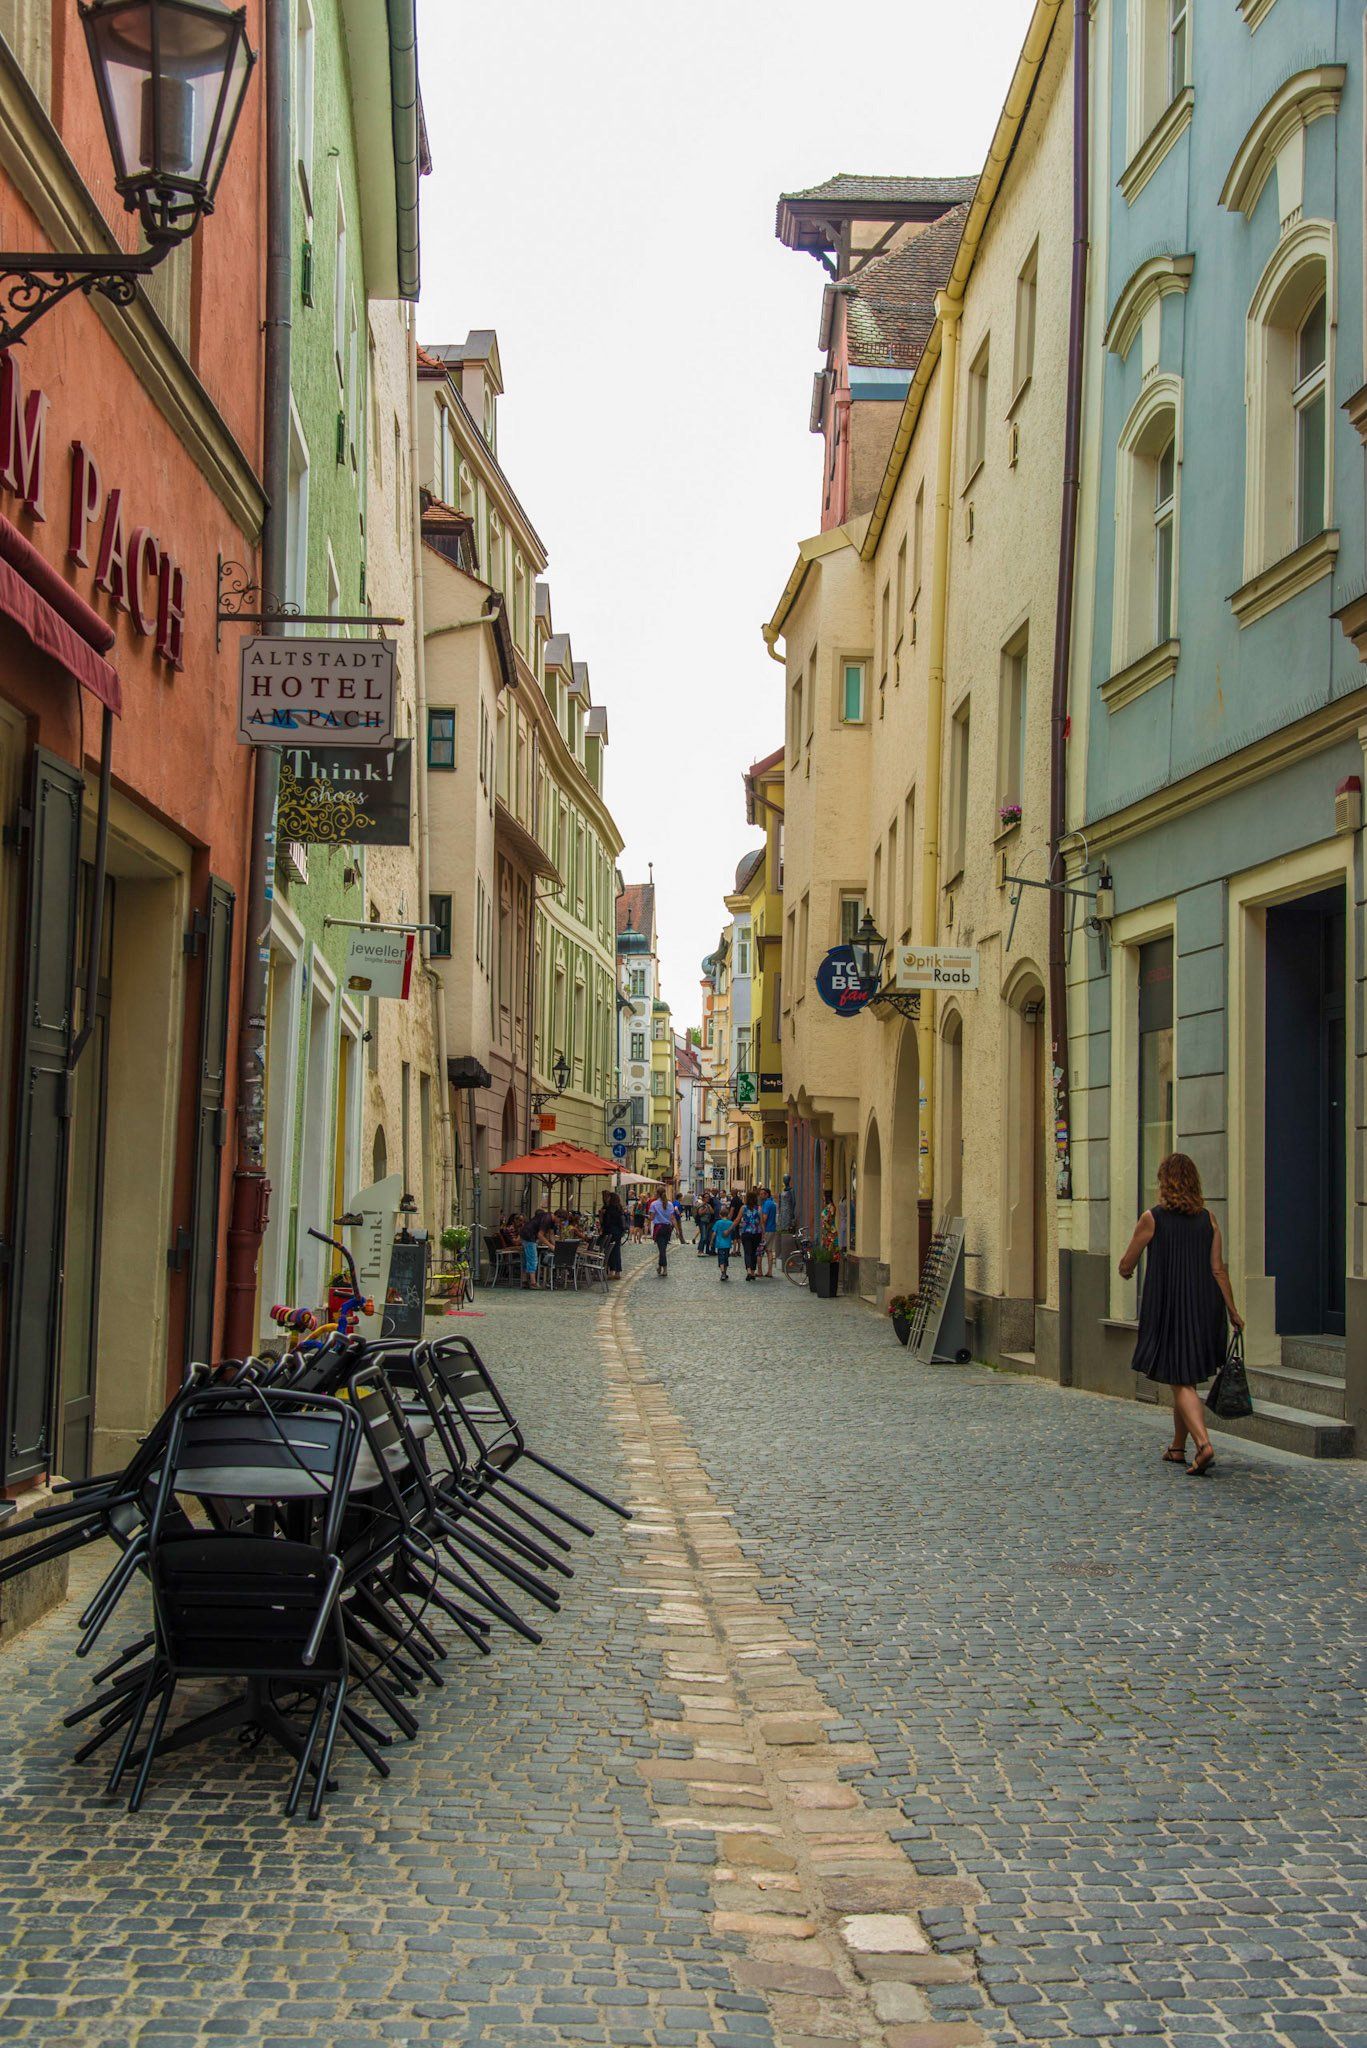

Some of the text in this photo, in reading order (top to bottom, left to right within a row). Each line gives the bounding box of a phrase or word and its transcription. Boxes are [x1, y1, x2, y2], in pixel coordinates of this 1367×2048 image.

[68, 440, 190, 672] PACH
[251, 651, 384, 668] ALTSTADT
[251, 676, 383, 700] HOTEL
[250, 708, 381, 728] AM PACH
[286, 749, 395, 782] Think!
[310, 785, 369, 805] shoes
[350, 941, 413, 962] jewellery
[903, 952, 942, 970] Optik
[832, 976, 861, 990] BE
[934, 968, 971, 984] Raab
[360, 1210, 382, 1283] Think!
